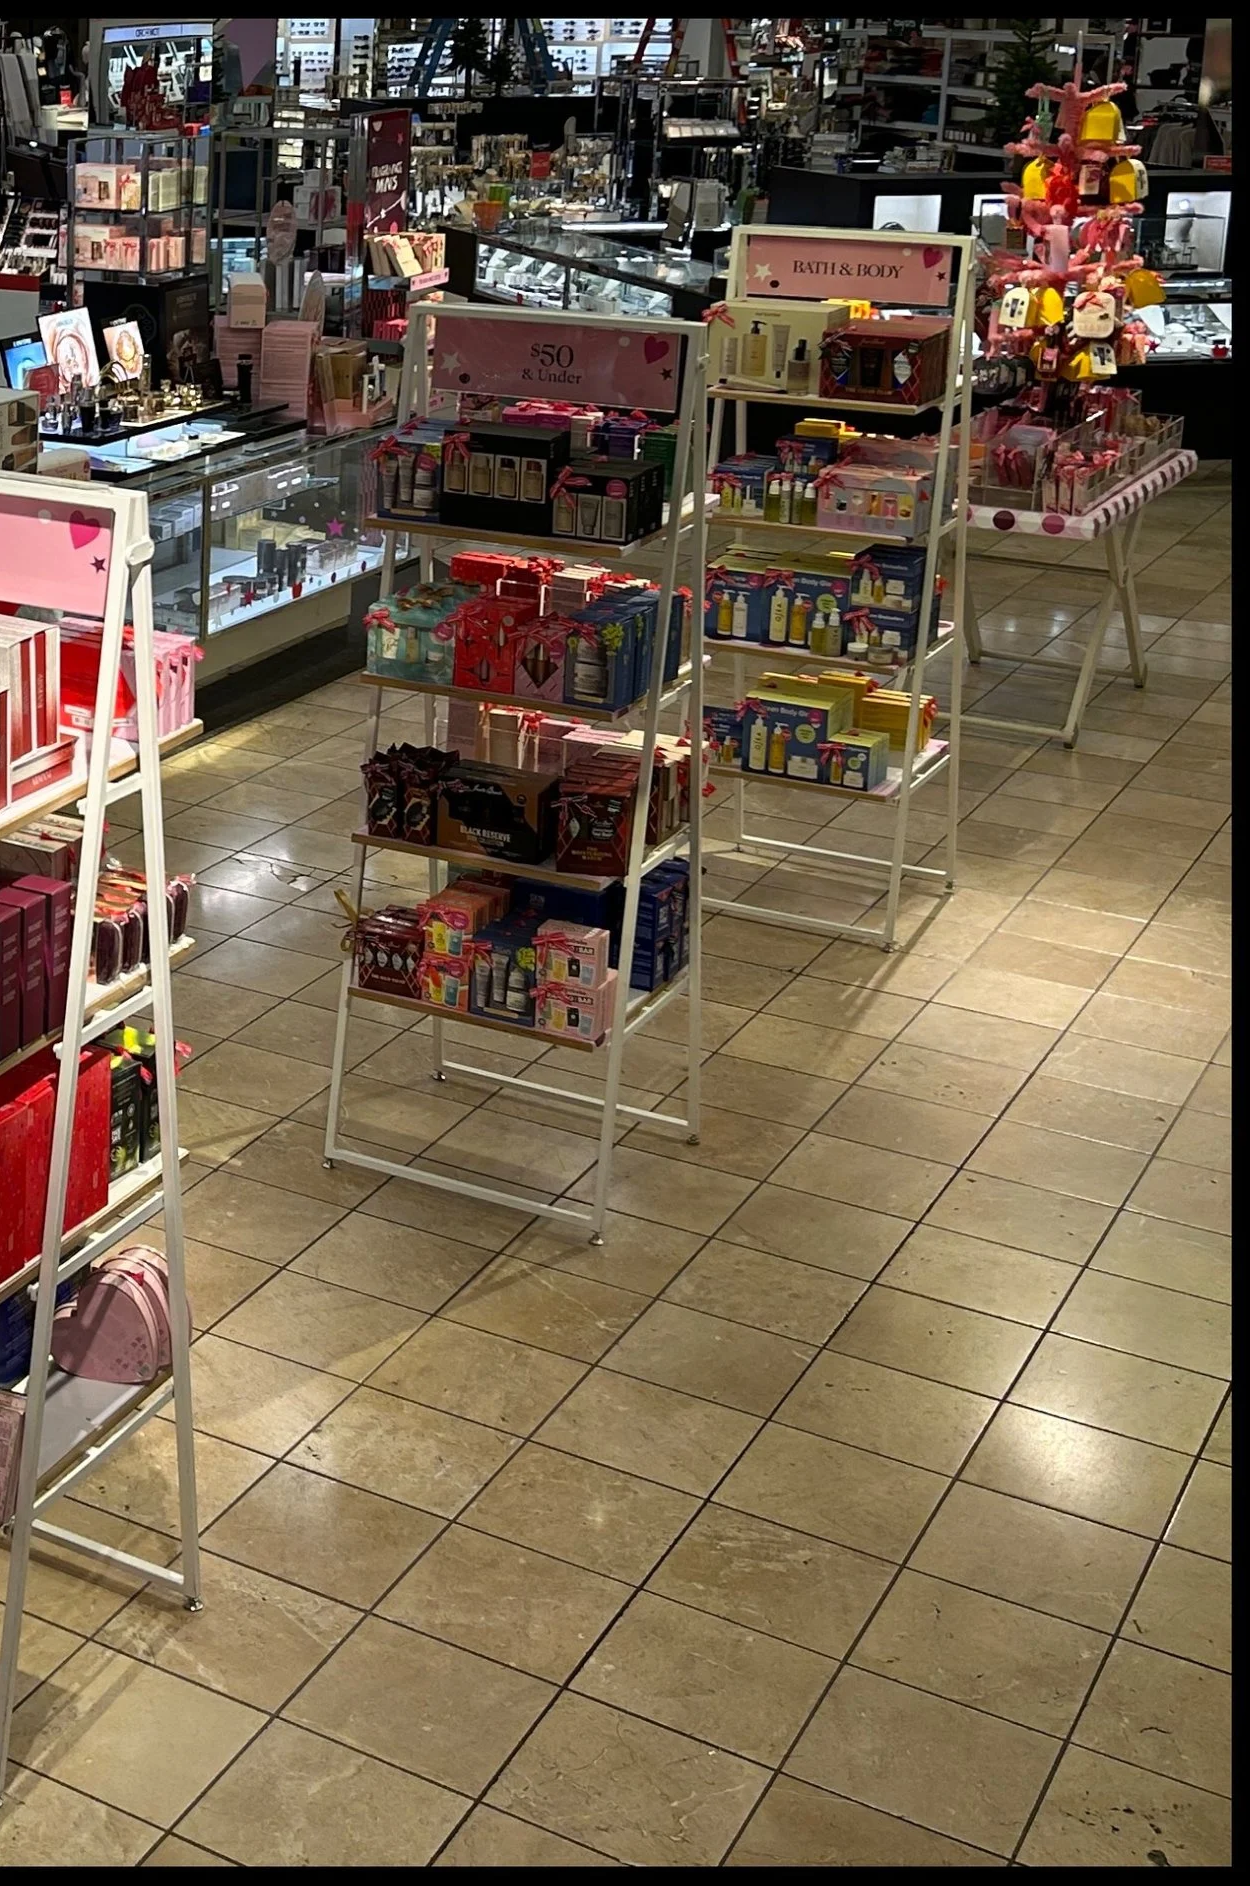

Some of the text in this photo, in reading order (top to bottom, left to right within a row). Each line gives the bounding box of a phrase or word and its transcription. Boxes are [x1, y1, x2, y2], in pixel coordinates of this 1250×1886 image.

[793, 260, 904, 279] BATH & BODY
[530, 343, 574, 368] $50
[522, 368, 582, 384] & Under
[460, 824, 481, 837] BLACK
[482, 828, 511, 843] RESERVE
